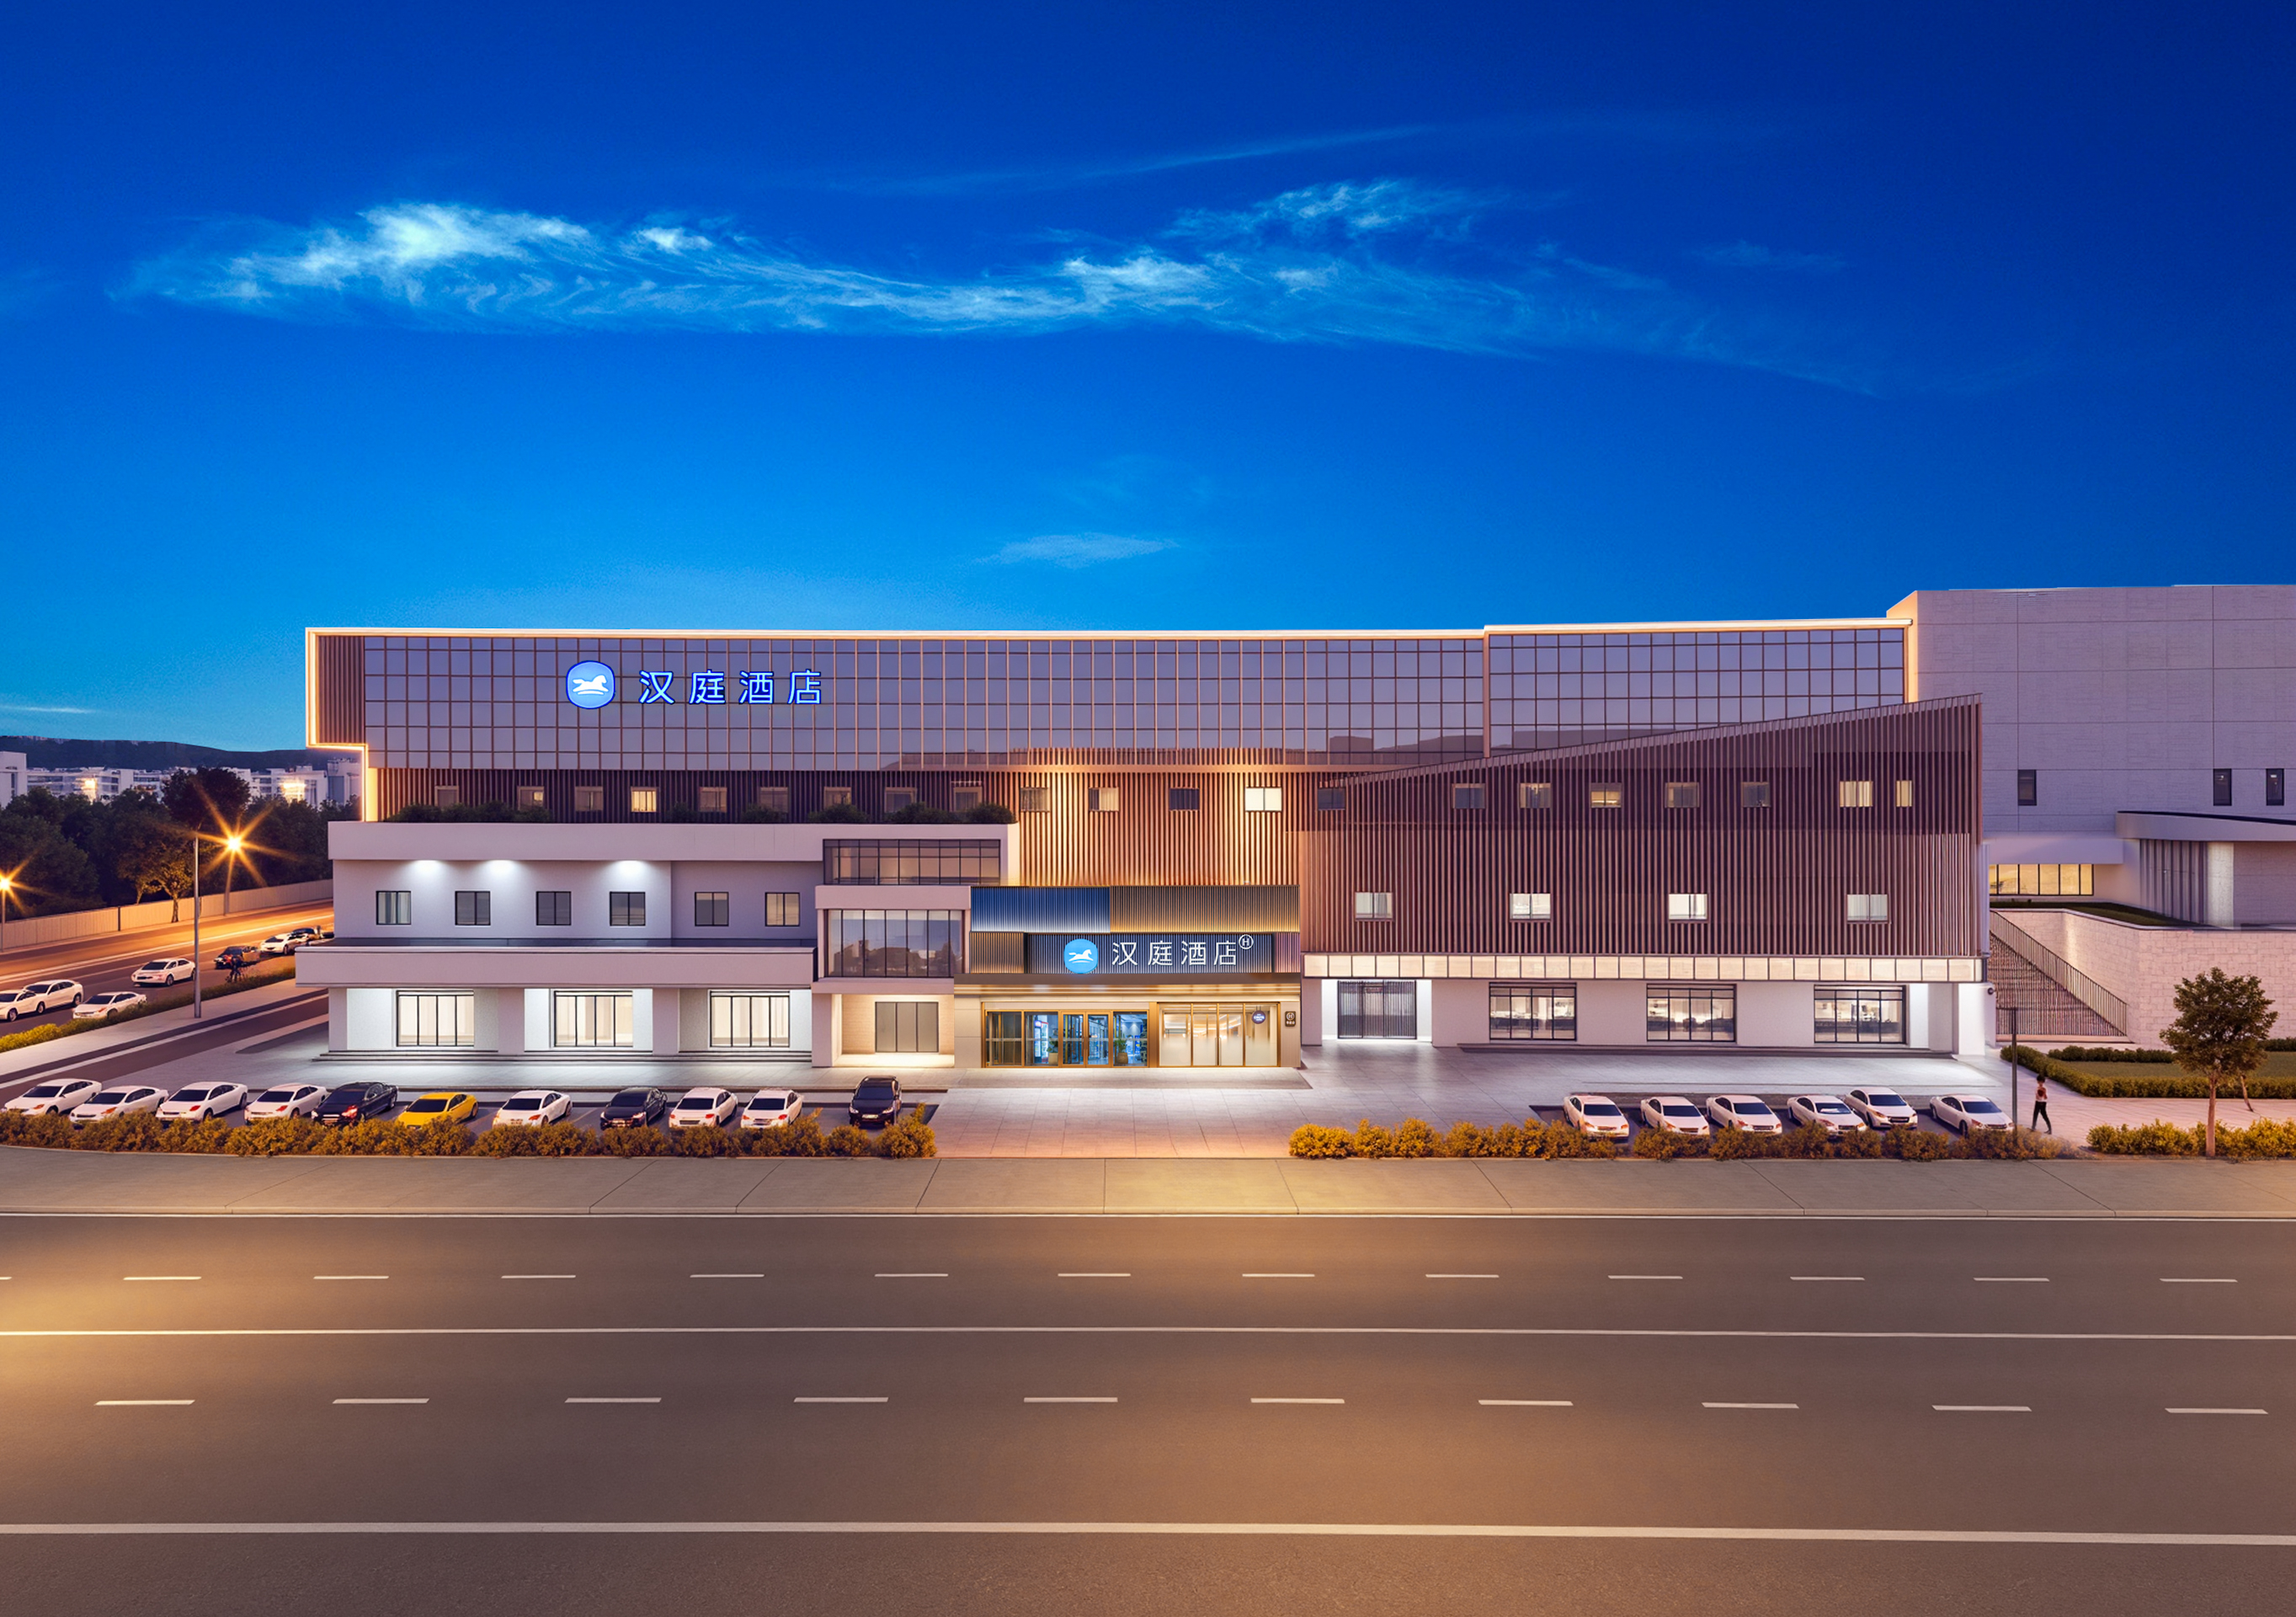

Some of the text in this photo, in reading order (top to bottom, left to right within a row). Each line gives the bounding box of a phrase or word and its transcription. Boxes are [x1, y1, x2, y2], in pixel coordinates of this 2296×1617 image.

[639, 670, 822, 704] 汉庭酒店
[1111, 940, 1237, 966] 汉庭酒店
